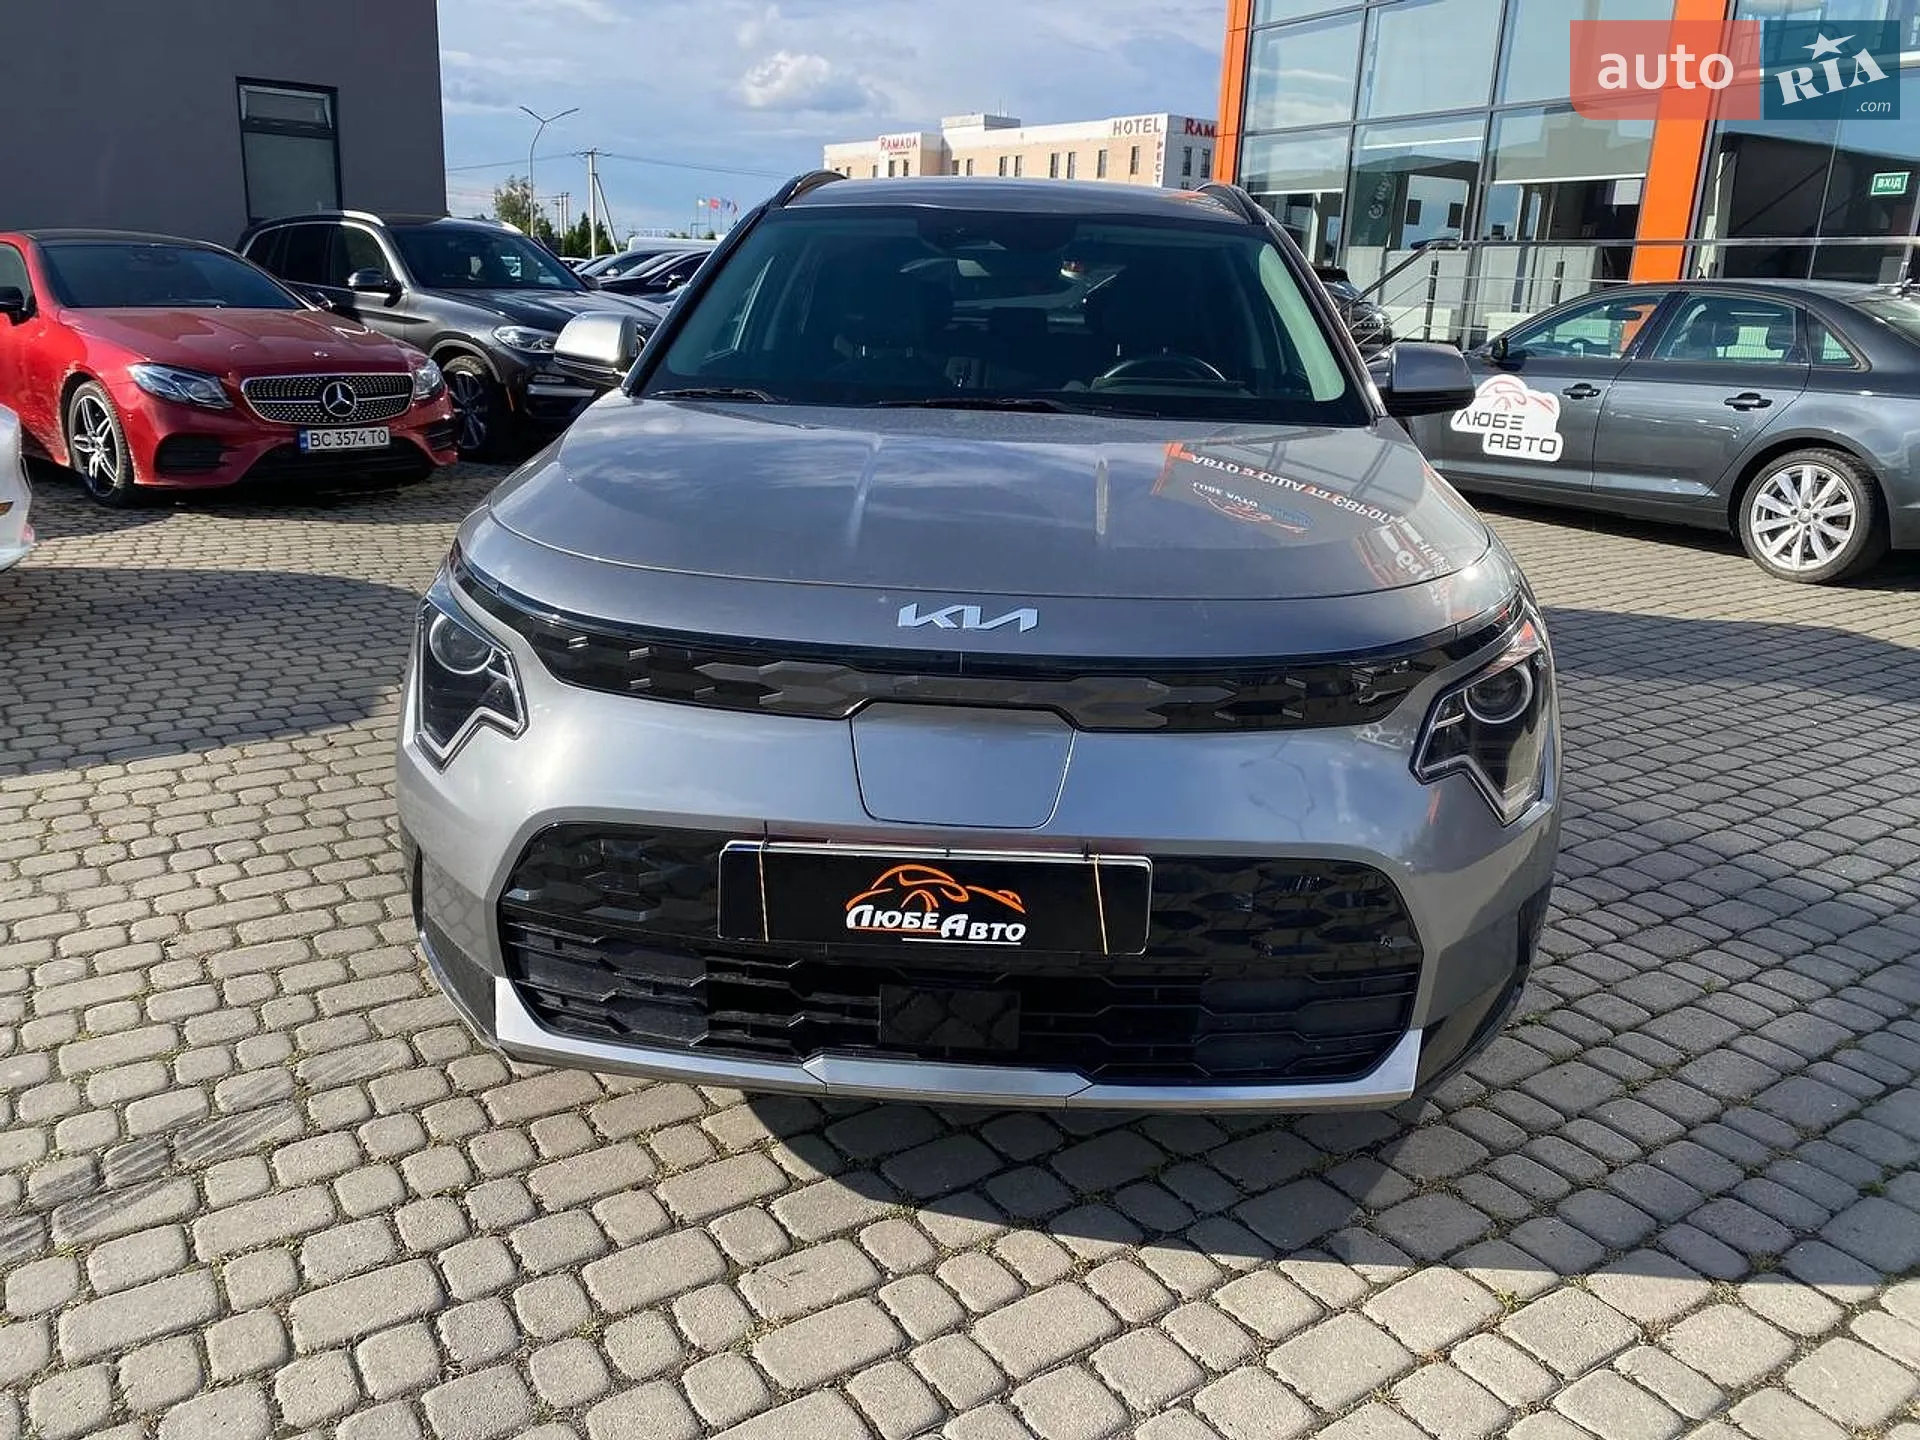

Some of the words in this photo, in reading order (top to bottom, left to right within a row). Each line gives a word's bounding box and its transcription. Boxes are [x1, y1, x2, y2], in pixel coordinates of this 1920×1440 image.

[1113, 118, 1161, 136] HOTEL
[880, 136, 918, 151] RAMADA
[1456, 411, 1525, 430] ЛЮБЕ
[310, 432, 331, 447] BC
[335, 430, 366, 446] 3574
[1488, 433, 1557, 454] АВТО
[898, 603, 1038, 632] KIA
